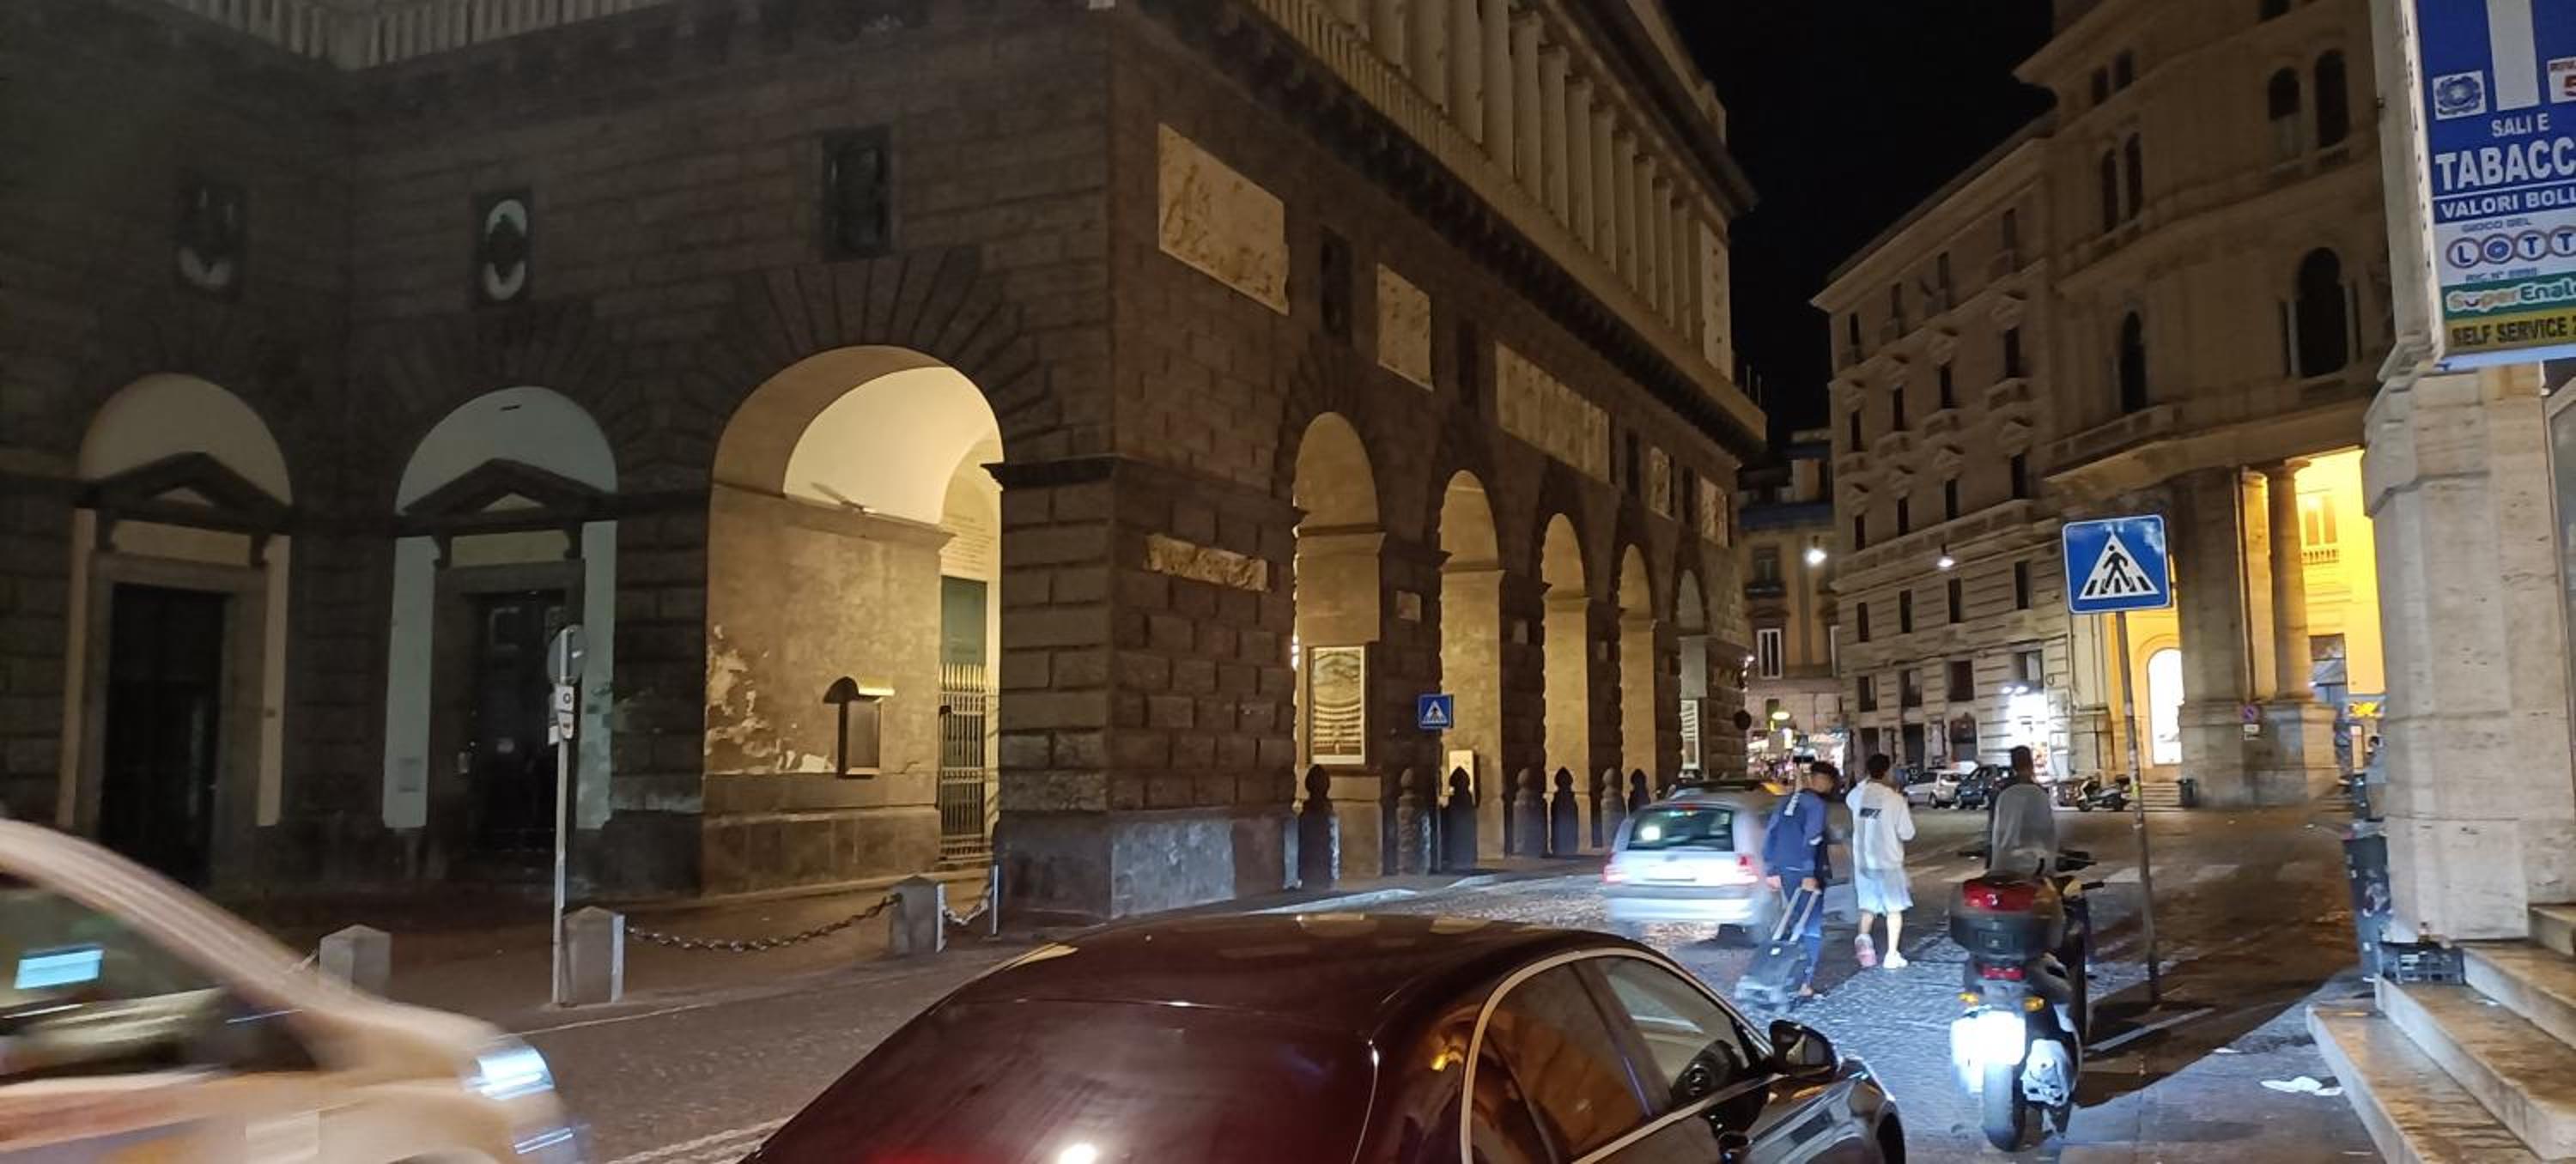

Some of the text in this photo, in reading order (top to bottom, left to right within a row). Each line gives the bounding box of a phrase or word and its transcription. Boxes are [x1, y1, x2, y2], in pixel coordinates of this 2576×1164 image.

[2492, 112, 2550, 137] SALI E
[2435, 136, 2576, 191] TABACC
[2440, 194, 2519, 219] VALORI
[2447, 277, 2576, 312] SuperEnal
[2452, 325, 2490, 345] SELF
[2497, 317, 2567, 343] SERVICE
